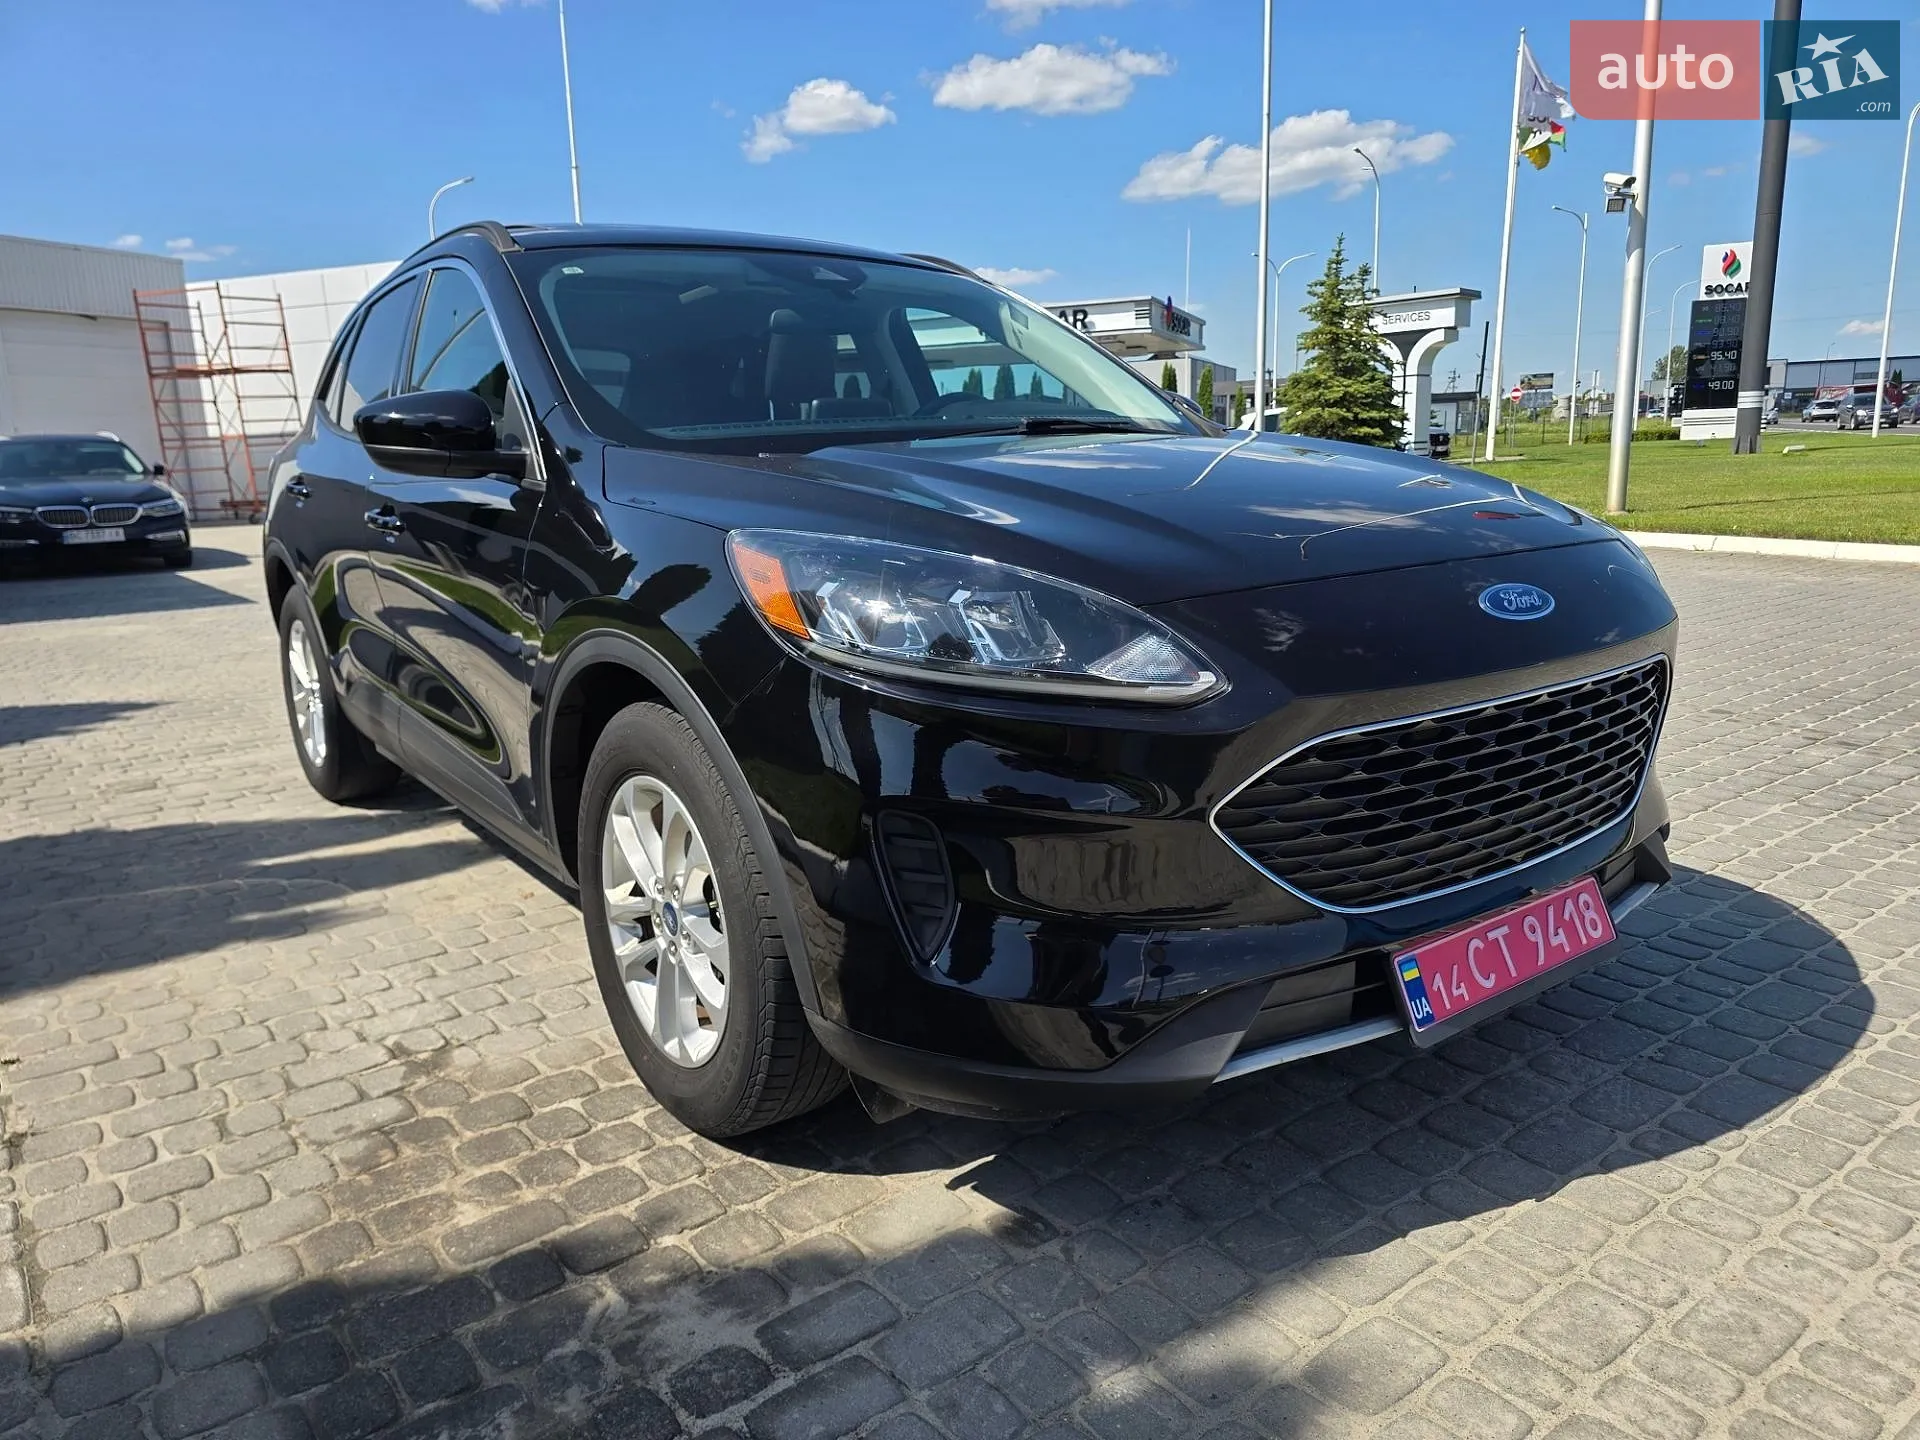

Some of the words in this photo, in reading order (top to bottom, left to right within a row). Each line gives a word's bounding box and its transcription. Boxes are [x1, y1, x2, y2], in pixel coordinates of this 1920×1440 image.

[1710, 350, 1738, 361] 95.40
[1500, 589, 1543, 611] Ford
[1411, 997, 1433, 1020] UA
